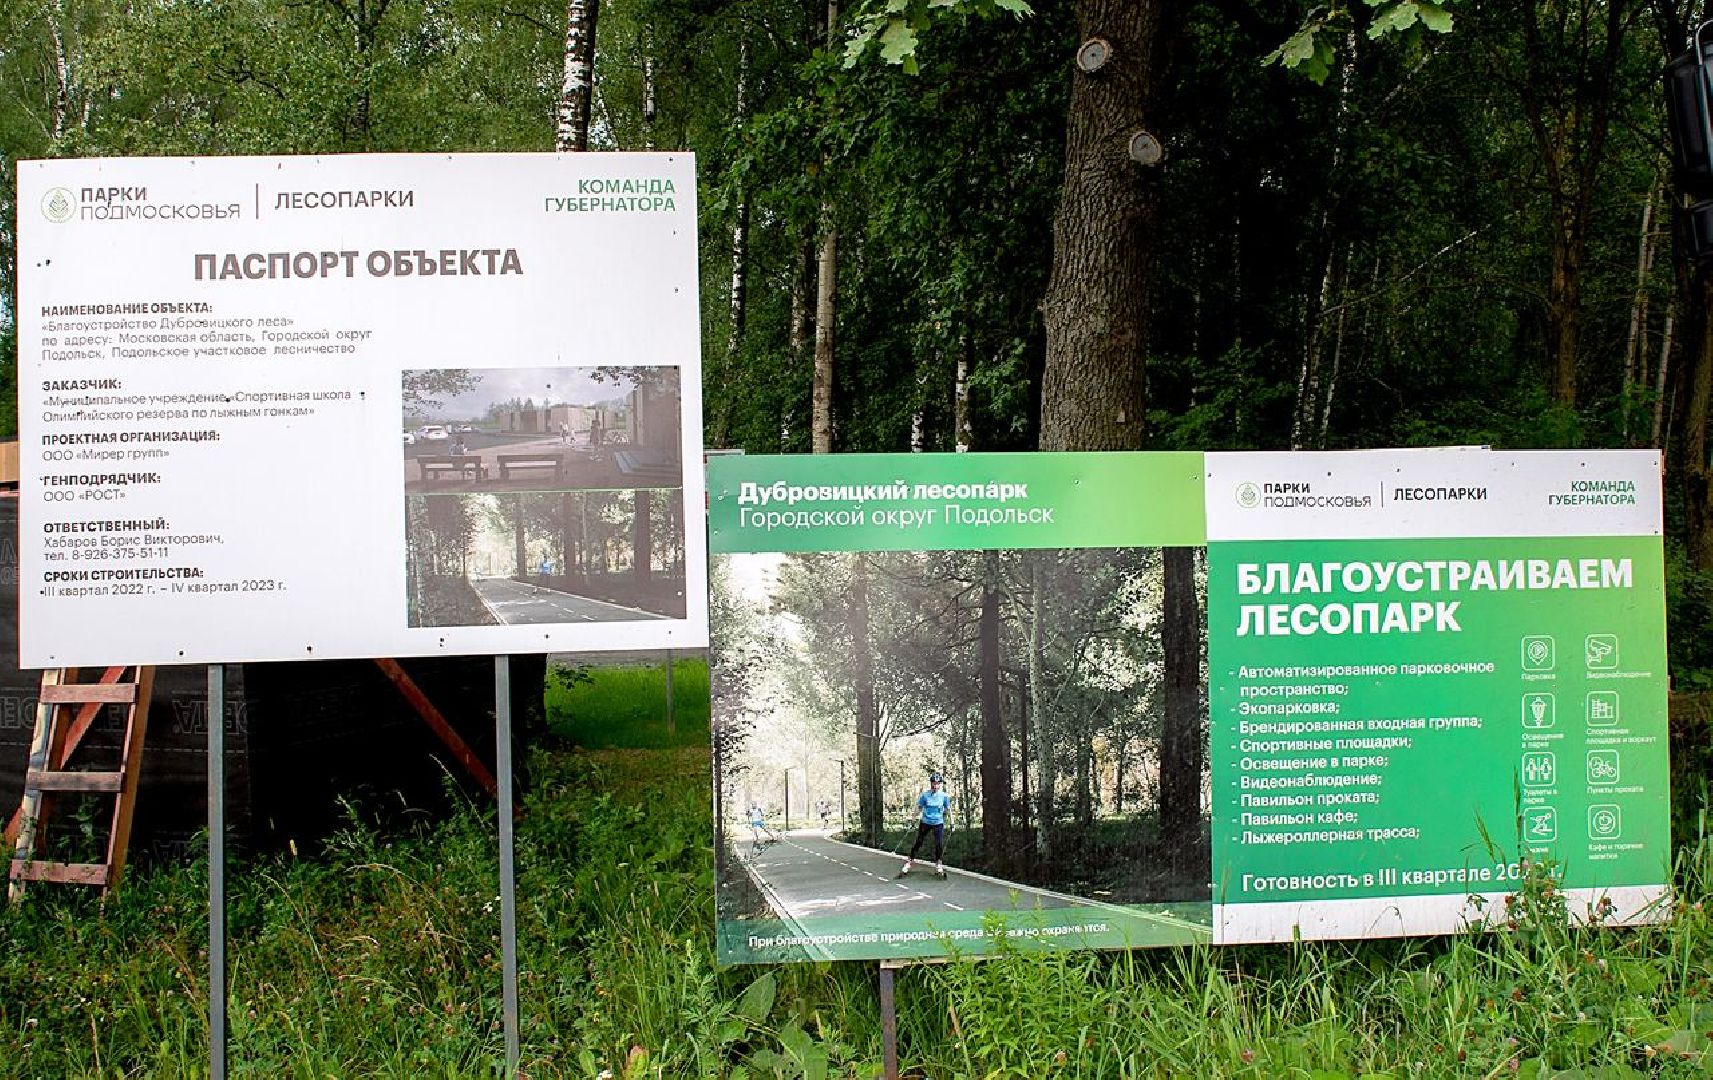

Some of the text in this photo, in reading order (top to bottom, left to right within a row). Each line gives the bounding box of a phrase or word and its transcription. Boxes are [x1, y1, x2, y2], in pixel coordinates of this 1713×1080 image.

[81, 187, 147, 202] ПАРКИ
[578, 179, 675, 195] КОМАНДА
[274, 191, 414, 209] ЛЕСОПАРКИ
[545, 196, 676, 212] ГУБЕРНАТОРА
[81, 203, 240, 220] ПОДМОСКОВЬЯ
[194, 248, 523, 280] ПАСПОРТ ОБЪЕКТА
[42, 302, 213, 317] НАИМЕНОВАНИЕ ОБЪЕКТА:
[42, 317, 294, 332] «Благоустройство Дубровицкого леса»
[42, 329, 372, 347] по адресу: Московская область, Городской округ
[42, 344, 356, 361] Подольск, Подольское участковое лесничество
[42, 379, 122, 391] ЗАКАЗЧИК:
[43, 394, 146, 408] «Муниципальное
[149, 393, 226, 405] учреждение
[313, 391, 351, 401] школа
[42, 407, 315, 422] Олимпийского резерва по лыжным гонкам»
[42, 430, 221, 446] ПРОЕКТНАЯ ОРГАНИЗАЦИЯ:
[43, 449, 170, 461] ООО «Мирер групп»
[43, 473, 161, 487] ГЕНПОДРЯДЧИК:
[1263, 482, 1311, 494] ПАРКИ
[1571, 480, 1635, 493] КОМАНДА
[43, 489, 126, 502] ООО «РОСТ»
[738, 480, 1028, 507] Дубровицкий лесопарк
[1263, 495, 1371, 508] ПОДМОСКОВЬЯ
[1394, 486, 1487, 501] ЛЕСОПАРКИ
[1547, 493, 1636, 506] ГУБЕРНАТОРА
[43, 518, 170, 534] ОТВЕТСТВЕННЫЙ:
[740, 505, 1055, 531] Городской округ Подольск
[44, 534, 225, 548] Хабаров Борис Викторович,
[44, 547, 169, 561] тел. 8-926-375-51-11
[43, 567, 204, 583] СРОКИ СТРОИТЕЛЬСТВА:
[1236, 558, 1633, 595] БЛАГОУСТРАИВАЕМ
[44, 586, 55, 597] III
[58, 586, 109, 598] квартал
[112, 583, 145, 596] 2022
[147, 585, 156, 596] г.
[171, 582, 185, 593] IV
[187, 582, 239, 594] квартал
[242, 580, 276, 592] 2023
[278, 582, 287, 592] г.
[1236, 601, 1462, 636] ЛЕСОПАРК
[1239, 663, 1397, 680] Автоматизированное
[1401, 661, 1494, 678] парковочное
[1241, 682, 1349, 699] пространство;
[1239, 701, 1340, 716] Экопарковка;
[172, 700, 248, 734] DETA
[1240, 717, 1364, 735] Брендированная
[1368, 717, 1426, 731] входная
[1428, 715, 1482, 731] группа;
[1240, 738, 1333, 754] Спортивные
[1336, 736, 1412, 752] площадки;
[1241, 757, 1328, 771] Освещение
[1331, 758, 1339, 767] в
[1342, 755, 1389, 770] парке;
[1241, 773, 1382, 790] Видеонаблюдение;
[1241, 793, 1313, 808] Павильон
[1318, 791, 1380, 807] проката;
[1242, 812, 1314, 827] Павильон
[1318, 810, 1358, 826] кафе;
[1241, 828, 1363, 846] Лыжероллерная
[1367, 825, 1420, 841] трасса;
[1242, 873, 1358, 893] Готовность
[1363, 874, 1373, 886] в
[1378, 867, 1396, 884] III
[1402, 865, 1490, 887] квартале
[749, 935, 773, 948] При
[949, 929, 984, 941] среда
